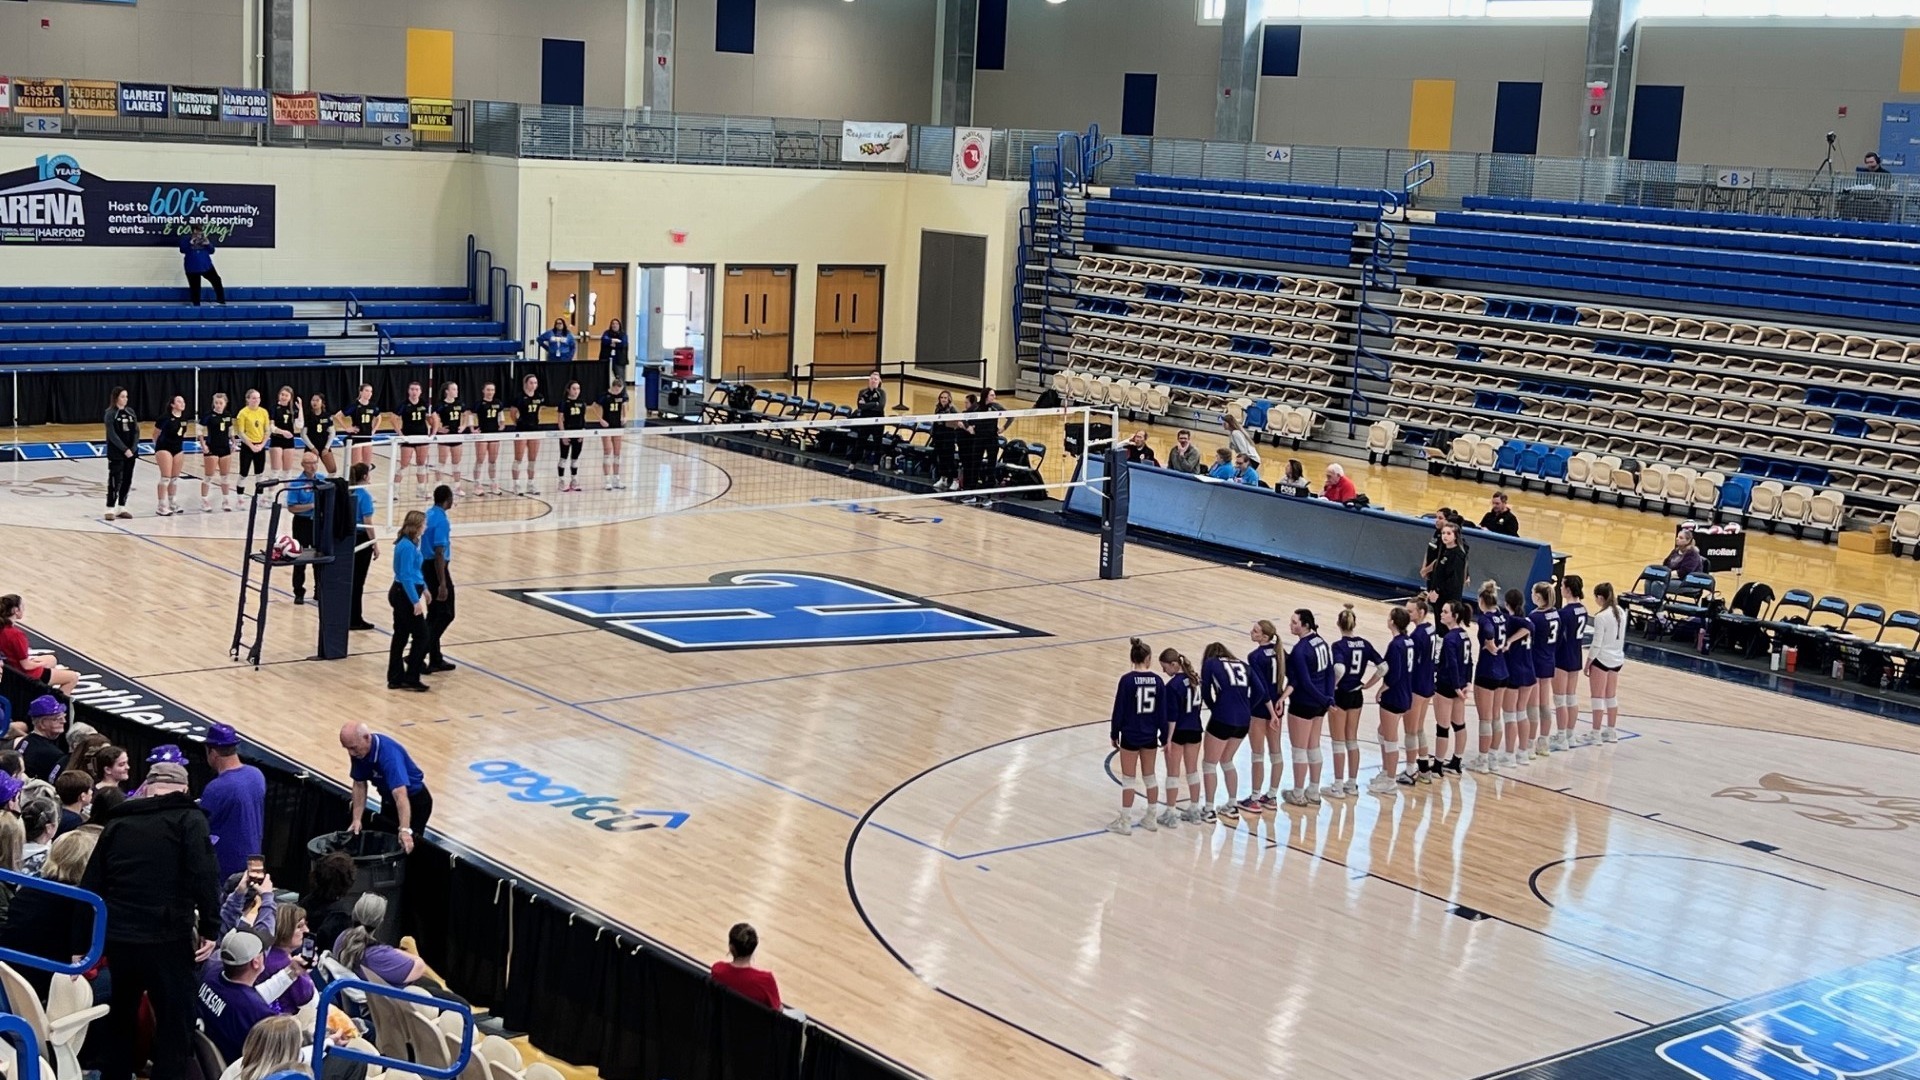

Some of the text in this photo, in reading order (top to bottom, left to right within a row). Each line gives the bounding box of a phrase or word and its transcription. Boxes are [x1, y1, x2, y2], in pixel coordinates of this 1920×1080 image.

[24, 86, 54, 97] ESSEX
[69, 87, 116, 99] FREDERICK
[123, 89, 166, 102] GARRETT
[18, 97, 60, 108] KNIGHTS
[69, 98, 116, 110] COUGARS
[172, 91, 218, 105] HAGERSTOWN
[223, 94, 266, 106] HARFORD
[126, 101, 163, 112] LAKERS
[178, 103, 212, 115] HAWKS
[275, 99, 313, 110] HOWARD
[250, 106, 268, 117] OWLS
[275, 109, 316, 120] DRAGONS
[321, 110, 361, 123] RAPTORS
[375, 112, 400, 123] OWLS
[38, 119, 46, 131] R
[417, 115, 447, 125] HAWKS
[394, 134, 402, 145] S
[845, 128, 904, 142] Respect the Game
[1273, 149, 1281, 161] A
[36, 154, 81, 185] 10
[55, 167, 81, 176] YEARS
[1731, 173, 1738, 186] B
[108, 187, 260, 216] Host to 600+ community,
[0, 193, 85, 226] ARENA
[108, 214, 254, 228] entertainment, and sporting
[39, 228, 85, 238] HARFORD
[1707, 547, 1736, 557] molten
[1547, 620, 1559, 644] 3
[1575, 615, 1586, 640] 2
[1497, 623, 1507, 649] 5
[1315, 643, 1329, 673] 10
[1350, 649, 1363, 675] 9
[1223, 660, 1248, 688] 13
[1271, 656, 1278, 685] 1
[1135, 685, 1157, 715] 15
[1186, 683, 1202, 714] 14
